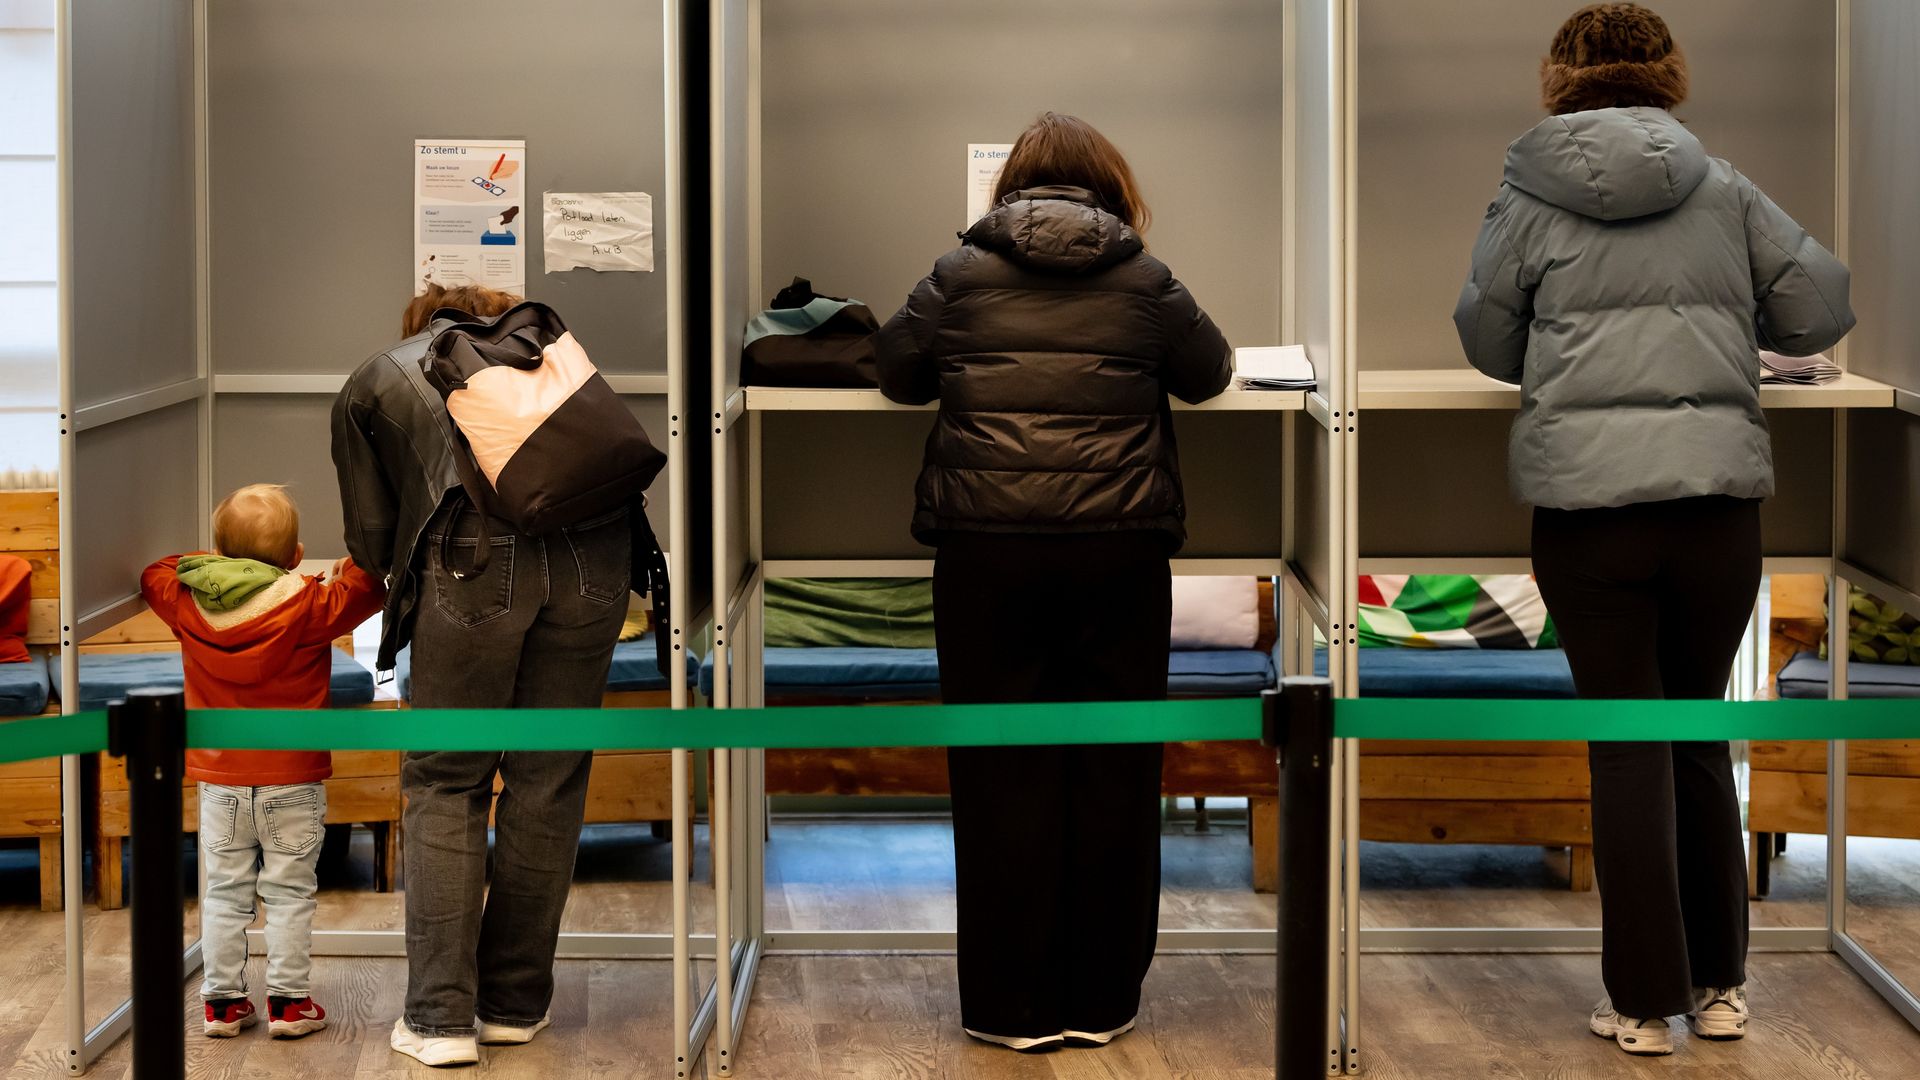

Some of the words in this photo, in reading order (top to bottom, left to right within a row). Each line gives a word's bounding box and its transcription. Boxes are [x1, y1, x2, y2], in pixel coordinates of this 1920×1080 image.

[420, 146, 431, 154] Zo
[434, 146, 459, 155] stemt
[973, 150, 985, 159] Zo
[987, 151, 1009, 159] stem
[601, 211, 626, 223] laten
[564, 226, 591, 241] liggen
